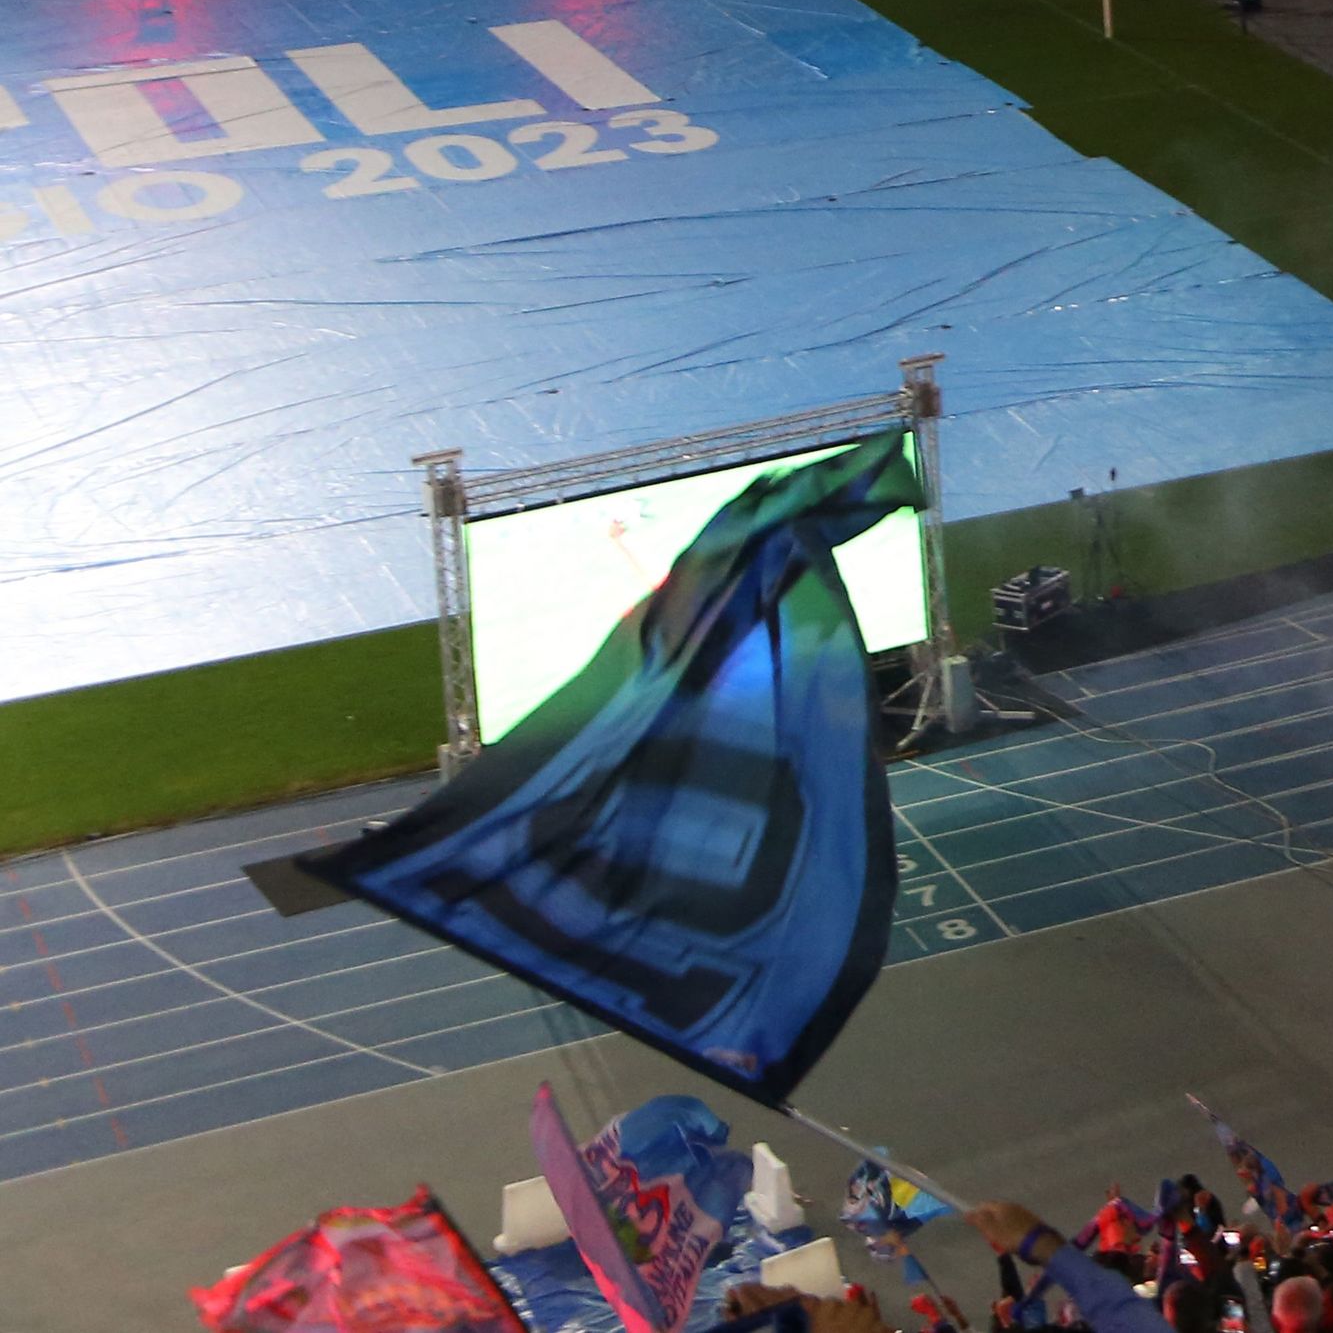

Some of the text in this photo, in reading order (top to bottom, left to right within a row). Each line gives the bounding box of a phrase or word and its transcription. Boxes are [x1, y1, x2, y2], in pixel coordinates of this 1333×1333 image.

[0, 19, 663, 167] OLI
[302, 109, 720, 200] 2023
[903, 883, 939, 908] 7
[935, 917, 979, 942] 8
